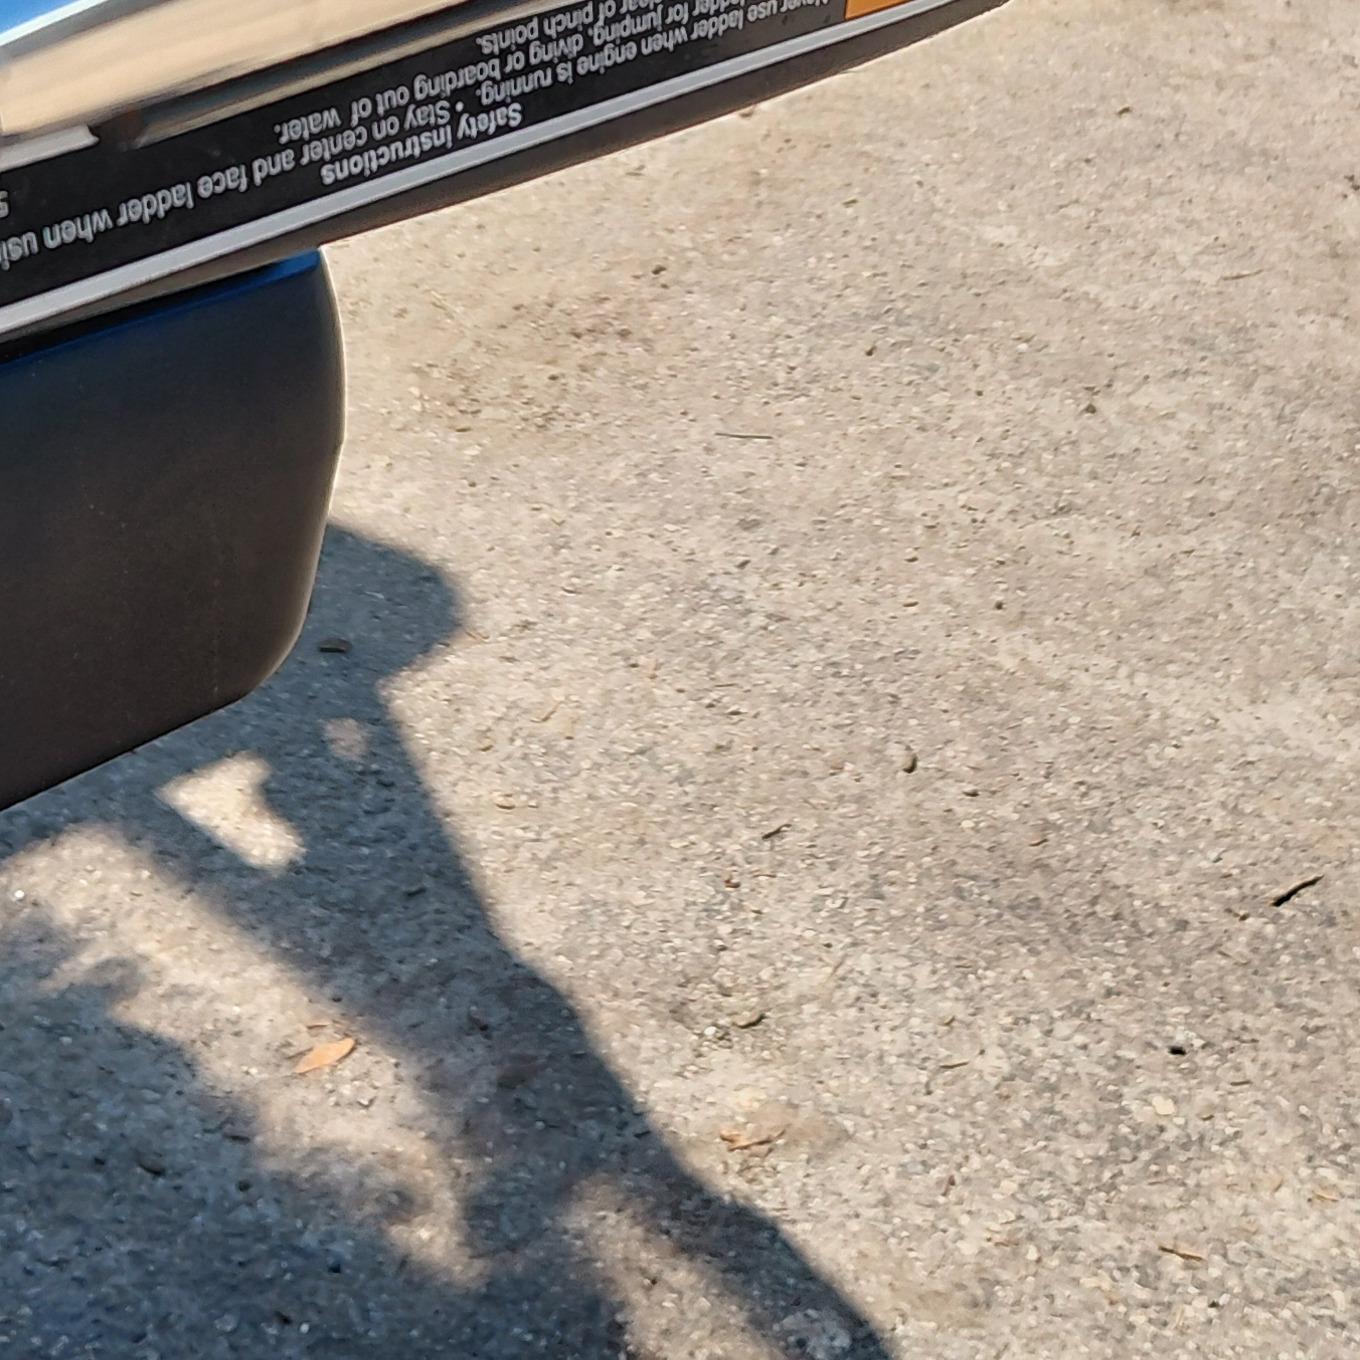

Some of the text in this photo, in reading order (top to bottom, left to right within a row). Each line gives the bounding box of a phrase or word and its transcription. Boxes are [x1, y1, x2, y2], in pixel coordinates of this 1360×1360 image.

[544, 1, 593, 38] pinch
[598, 0, 616, 24] of
[665, 2, 688, 26] for
[690, 9, 743, 40] ladder
[747, 0, 778, 22] use
[476, 17, 538, 55] points.
[529, 34, 584, 65] diving
[641, 26, 688, 55] when
[504, 51, 525, 73] or
[556, 62, 573, 85] is
[576, 41, 638, 74] engine
[414, 58, 500, 98] boarding
[476, 68, 552, 106] running.
[350, 98, 372, 126] of
[375, 85, 410, 110] out
[274, 108, 341, 144] water.
[372, 115, 400, 140] on
[404, 100, 450, 130] Stay
[457, 102, 522, 140] Safety
[300, 126, 368, 166] center
[197, 165, 248, 199] face
[252, 148, 295, 186] and
[116, 182, 194, 227] ladder
[42, 209, 113, 250] when
